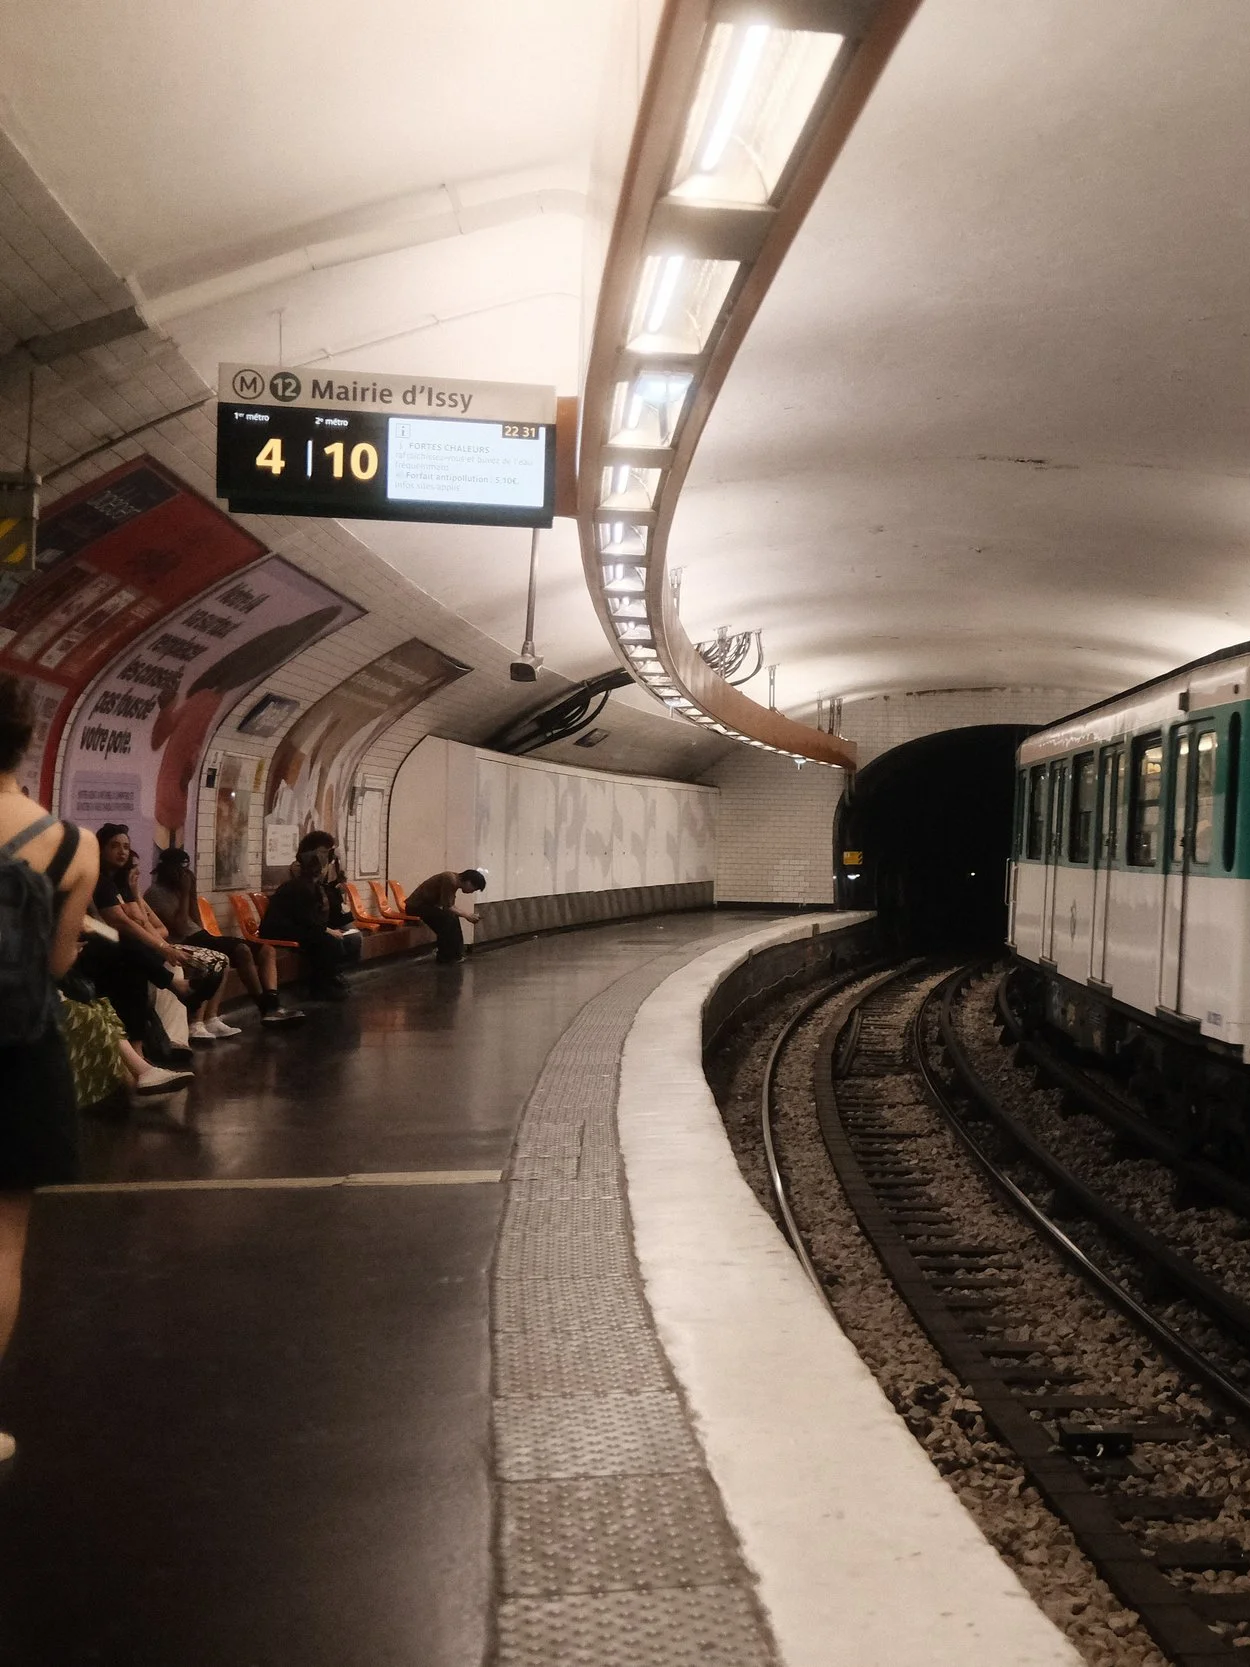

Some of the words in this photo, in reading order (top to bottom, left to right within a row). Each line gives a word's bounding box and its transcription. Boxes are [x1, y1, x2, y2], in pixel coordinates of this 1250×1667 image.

[273, 378, 297, 397] 12
[311, 379, 393, 404] Mairie
[402, 384, 473, 414] d'Issy
[246, 413, 269, 422] métro
[325, 418, 348, 427] métro
[505, 425, 519, 437] 22
[523, 427, 536, 438] 31
[409, 442, 442, 451] FORTES
[444, 443, 491, 454] CHALEURS
[255, 438, 285, 476] 4
[323, 441, 379, 480] 10
[406, 471, 434, 481] Forfait
[435, 473, 489, 485] antipollution
[80, 722, 110, 752] votre
